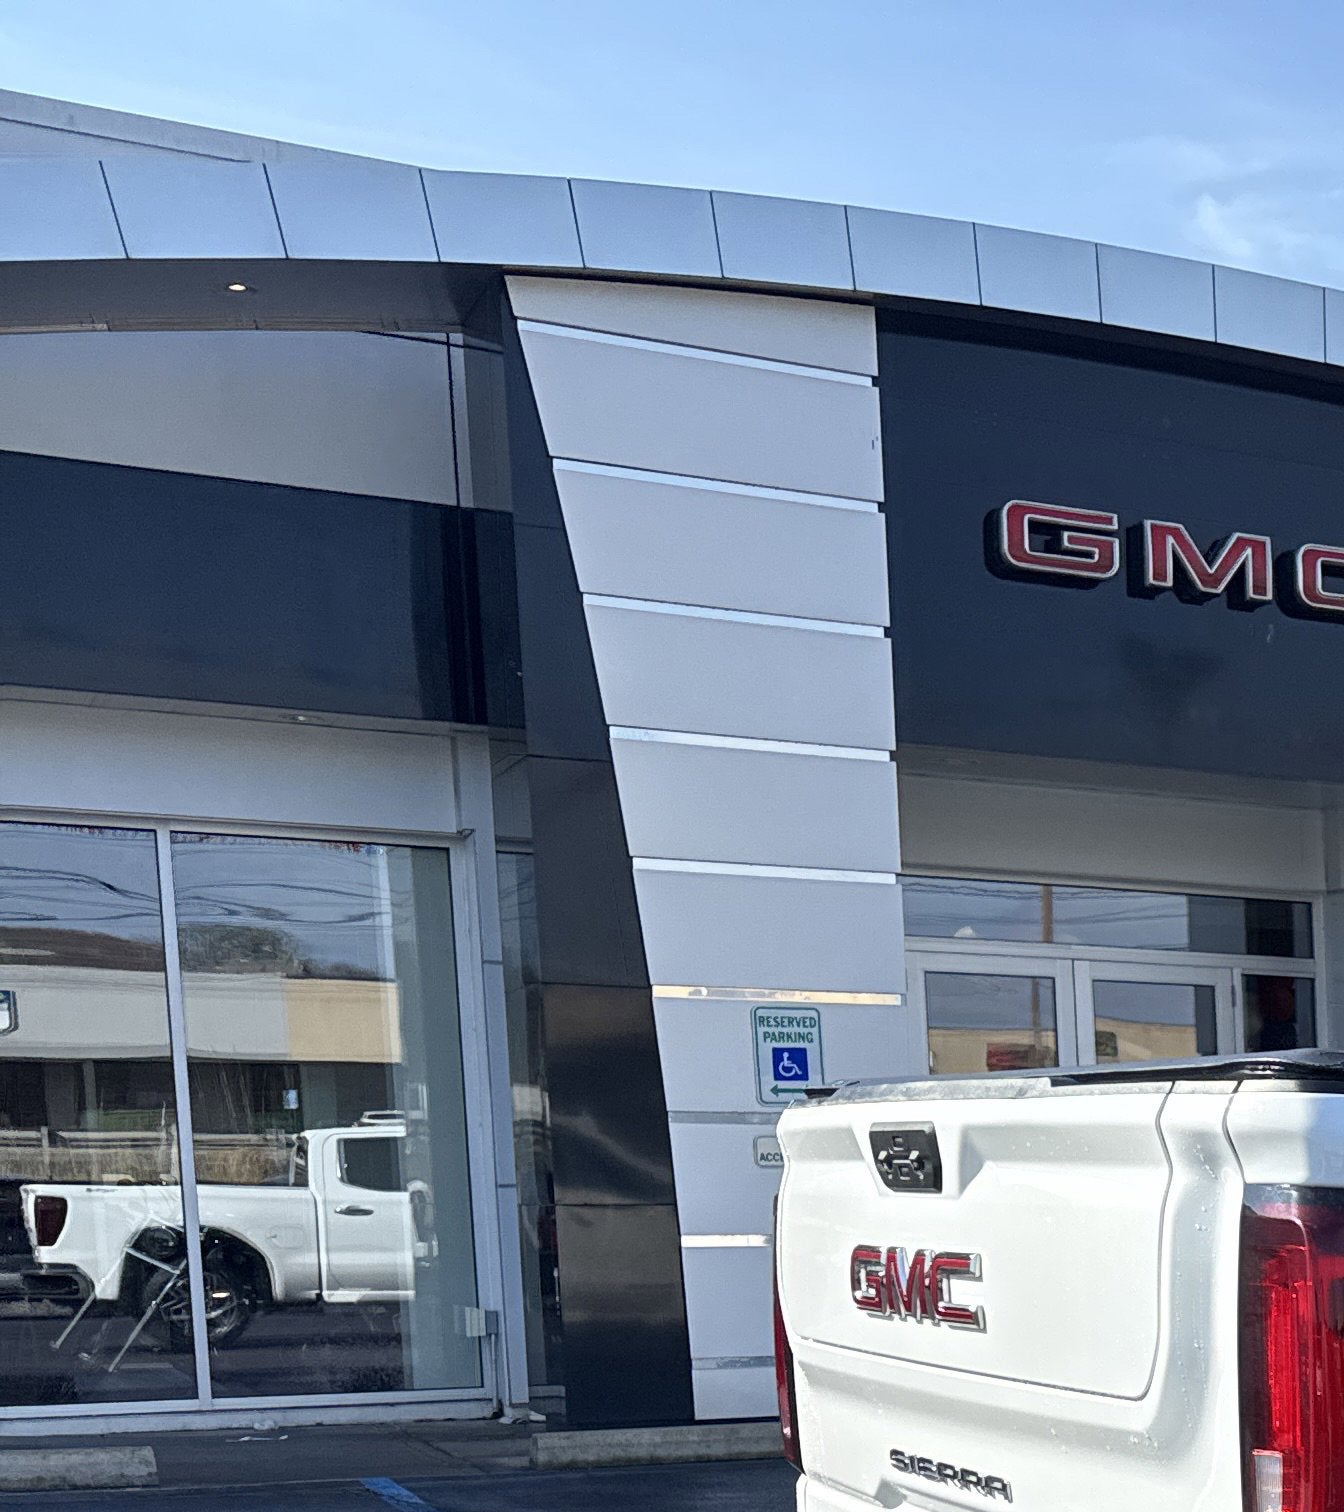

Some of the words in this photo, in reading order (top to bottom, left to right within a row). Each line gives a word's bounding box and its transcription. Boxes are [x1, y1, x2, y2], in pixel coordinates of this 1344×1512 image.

[758, 1015, 817, 1029] RESERVED
[763, 1031, 814, 1044] PARKING
[850, 1244, 986, 1333] GMC
[889, 1448, 1014, 1503] SIERRA
